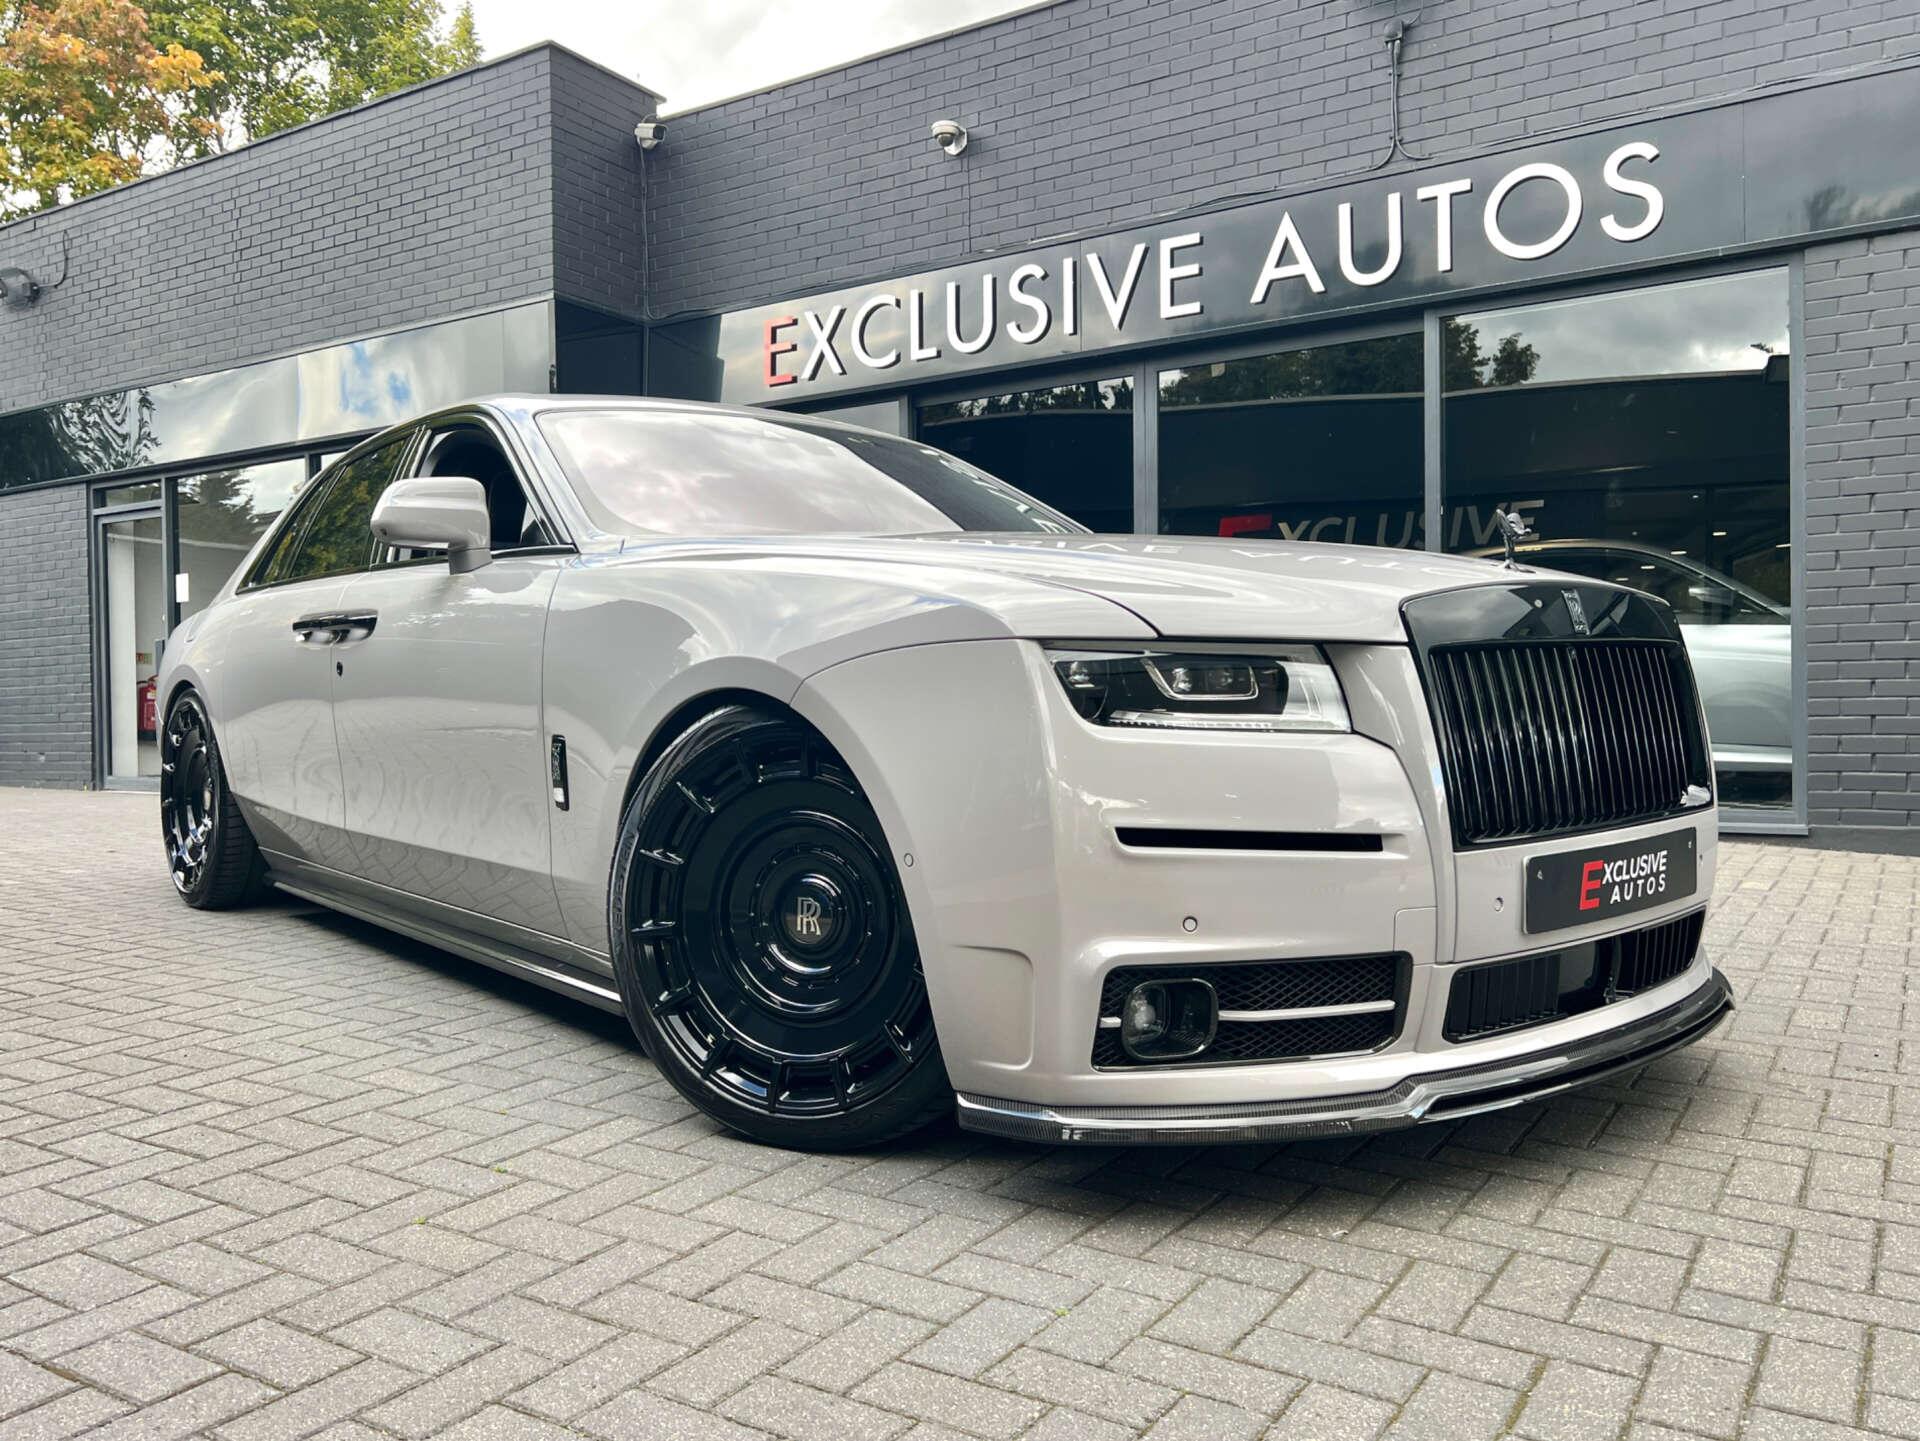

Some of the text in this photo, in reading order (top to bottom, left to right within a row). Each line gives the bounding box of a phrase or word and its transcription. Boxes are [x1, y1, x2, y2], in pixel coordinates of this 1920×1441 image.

[763, 142, 1665, 387] EXCLUSIVE AUTOS
[1580, 851, 1667, 910] EXCLUSIVE
[1611, 874, 1665, 904] AUTOS
